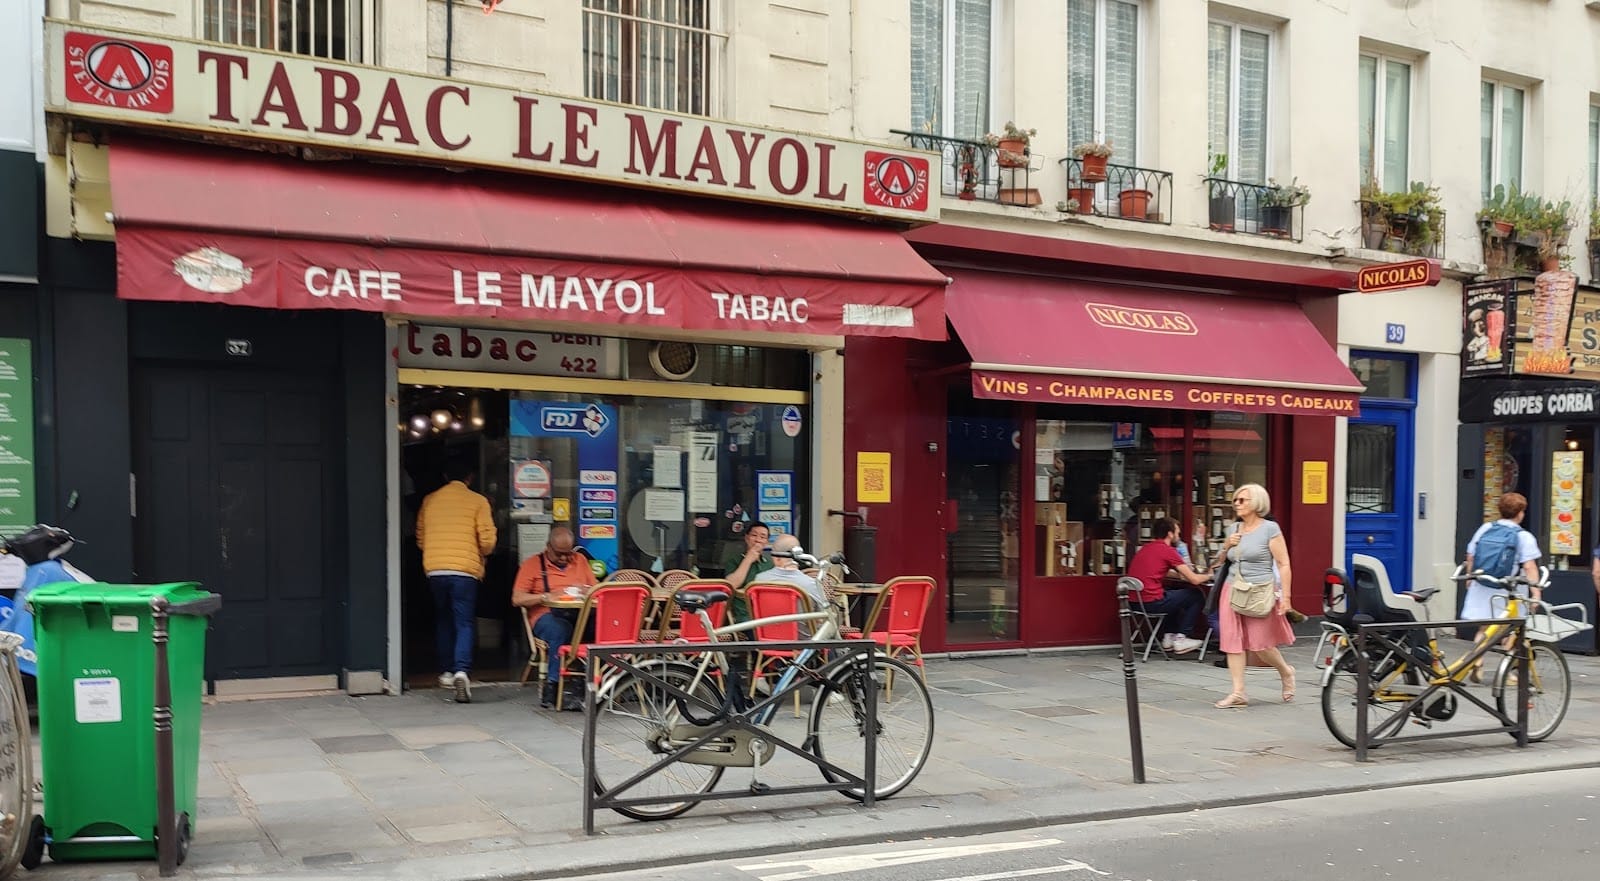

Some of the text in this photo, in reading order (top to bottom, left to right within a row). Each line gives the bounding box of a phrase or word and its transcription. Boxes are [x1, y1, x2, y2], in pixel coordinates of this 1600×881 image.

[68, 46, 170, 109] STELLA ARTOIS
[197, 50, 848, 203] TABAC LE MAYOL
[865, 160, 928, 209] STELLA ARTOIS
[1363, 265, 1426, 288] NICOLAS
[304, 266, 402, 301] CAFE
[453, 269, 502, 307] LE
[520, 274, 666, 316] MAYOL
[711, 292, 809, 324] TABAC
[1092, 307, 1191, 332] NICOLAS
[1388, 324, 1403, 343] 39
[408, 323, 537, 362] tabac
[560, 357, 598, 373] 422
[981, 376, 1029, 395] VINS
[1049, 382, 1174, 403] CHAMPAGNES
[1187, 388, 1277, 407] COFFRETS
[1280, 393, 1355, 412] CADEAUX
[1493, 396, 1544, 416] SOUPES
[546, 412, 579, 428] FDJ
